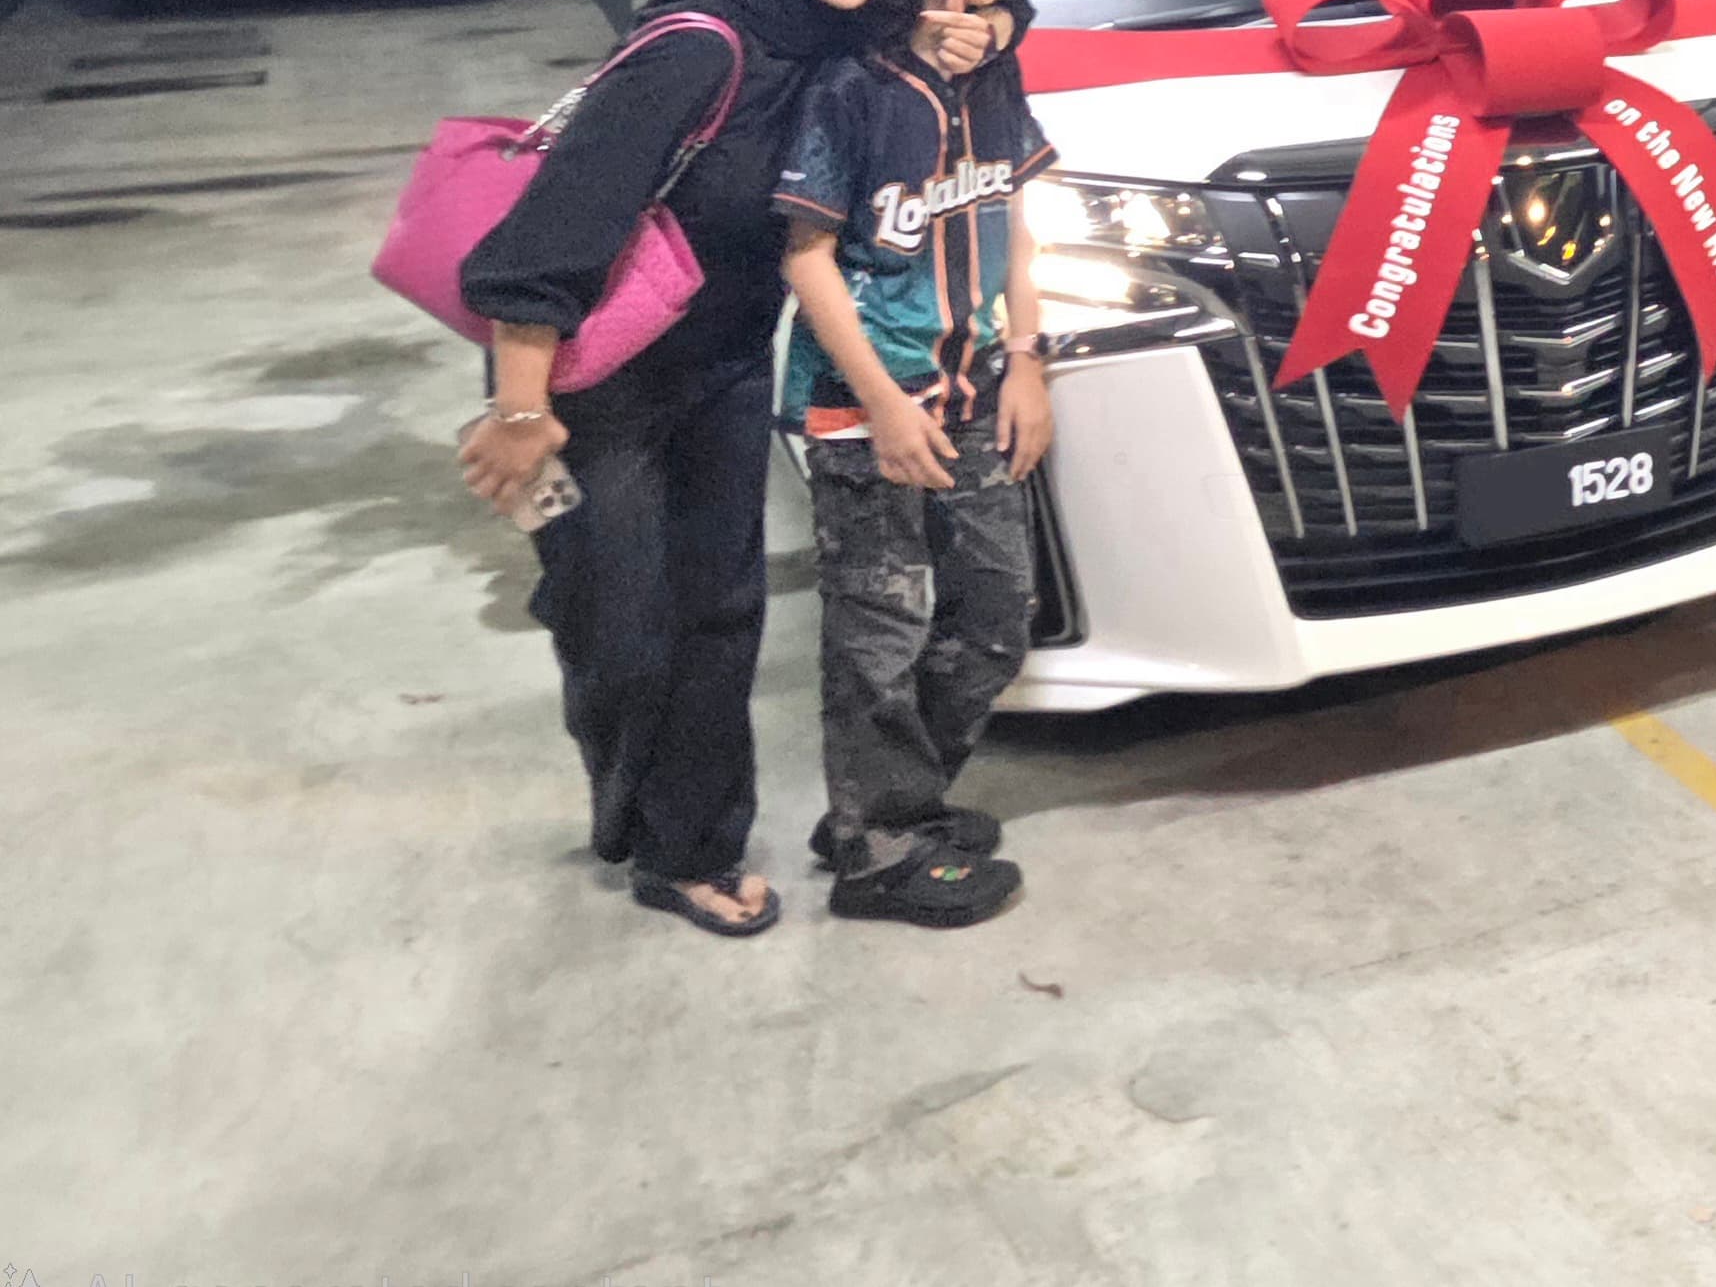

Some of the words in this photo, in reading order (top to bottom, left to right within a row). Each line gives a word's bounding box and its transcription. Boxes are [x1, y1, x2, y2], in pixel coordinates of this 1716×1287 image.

[1347, 114, 1461, 339] Congratulations
[1603, 98, 1643, 127] on
[1635, 120, 1681, 170] the
[1670, 163, 1716, 232] New
[1567, 451, 1654, 507] 1528
